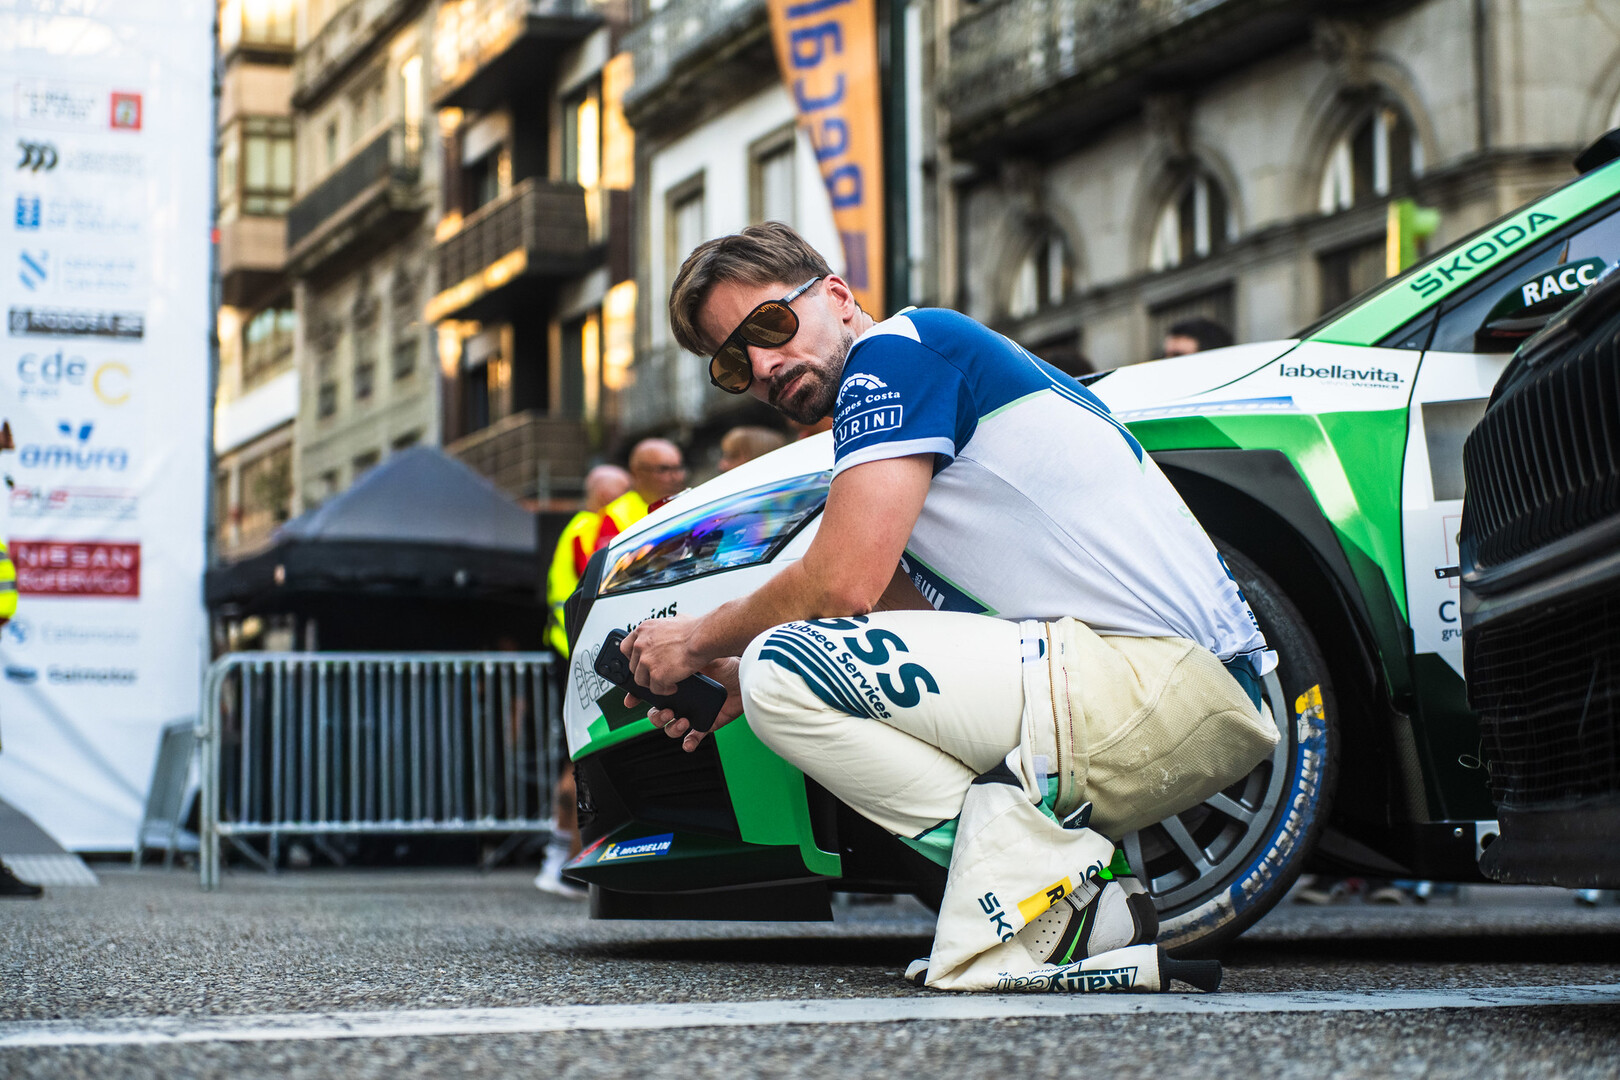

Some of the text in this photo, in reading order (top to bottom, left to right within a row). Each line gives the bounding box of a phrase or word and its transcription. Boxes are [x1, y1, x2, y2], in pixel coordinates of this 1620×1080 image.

[1521, 263, 1599, 307] RACC
[865, 391, 901, 404] Costa
[19, 443, 128, 472] amura
[782, 622, 892, 719] Subsea Services
[620, 841, 671, 855] MICHELIN
